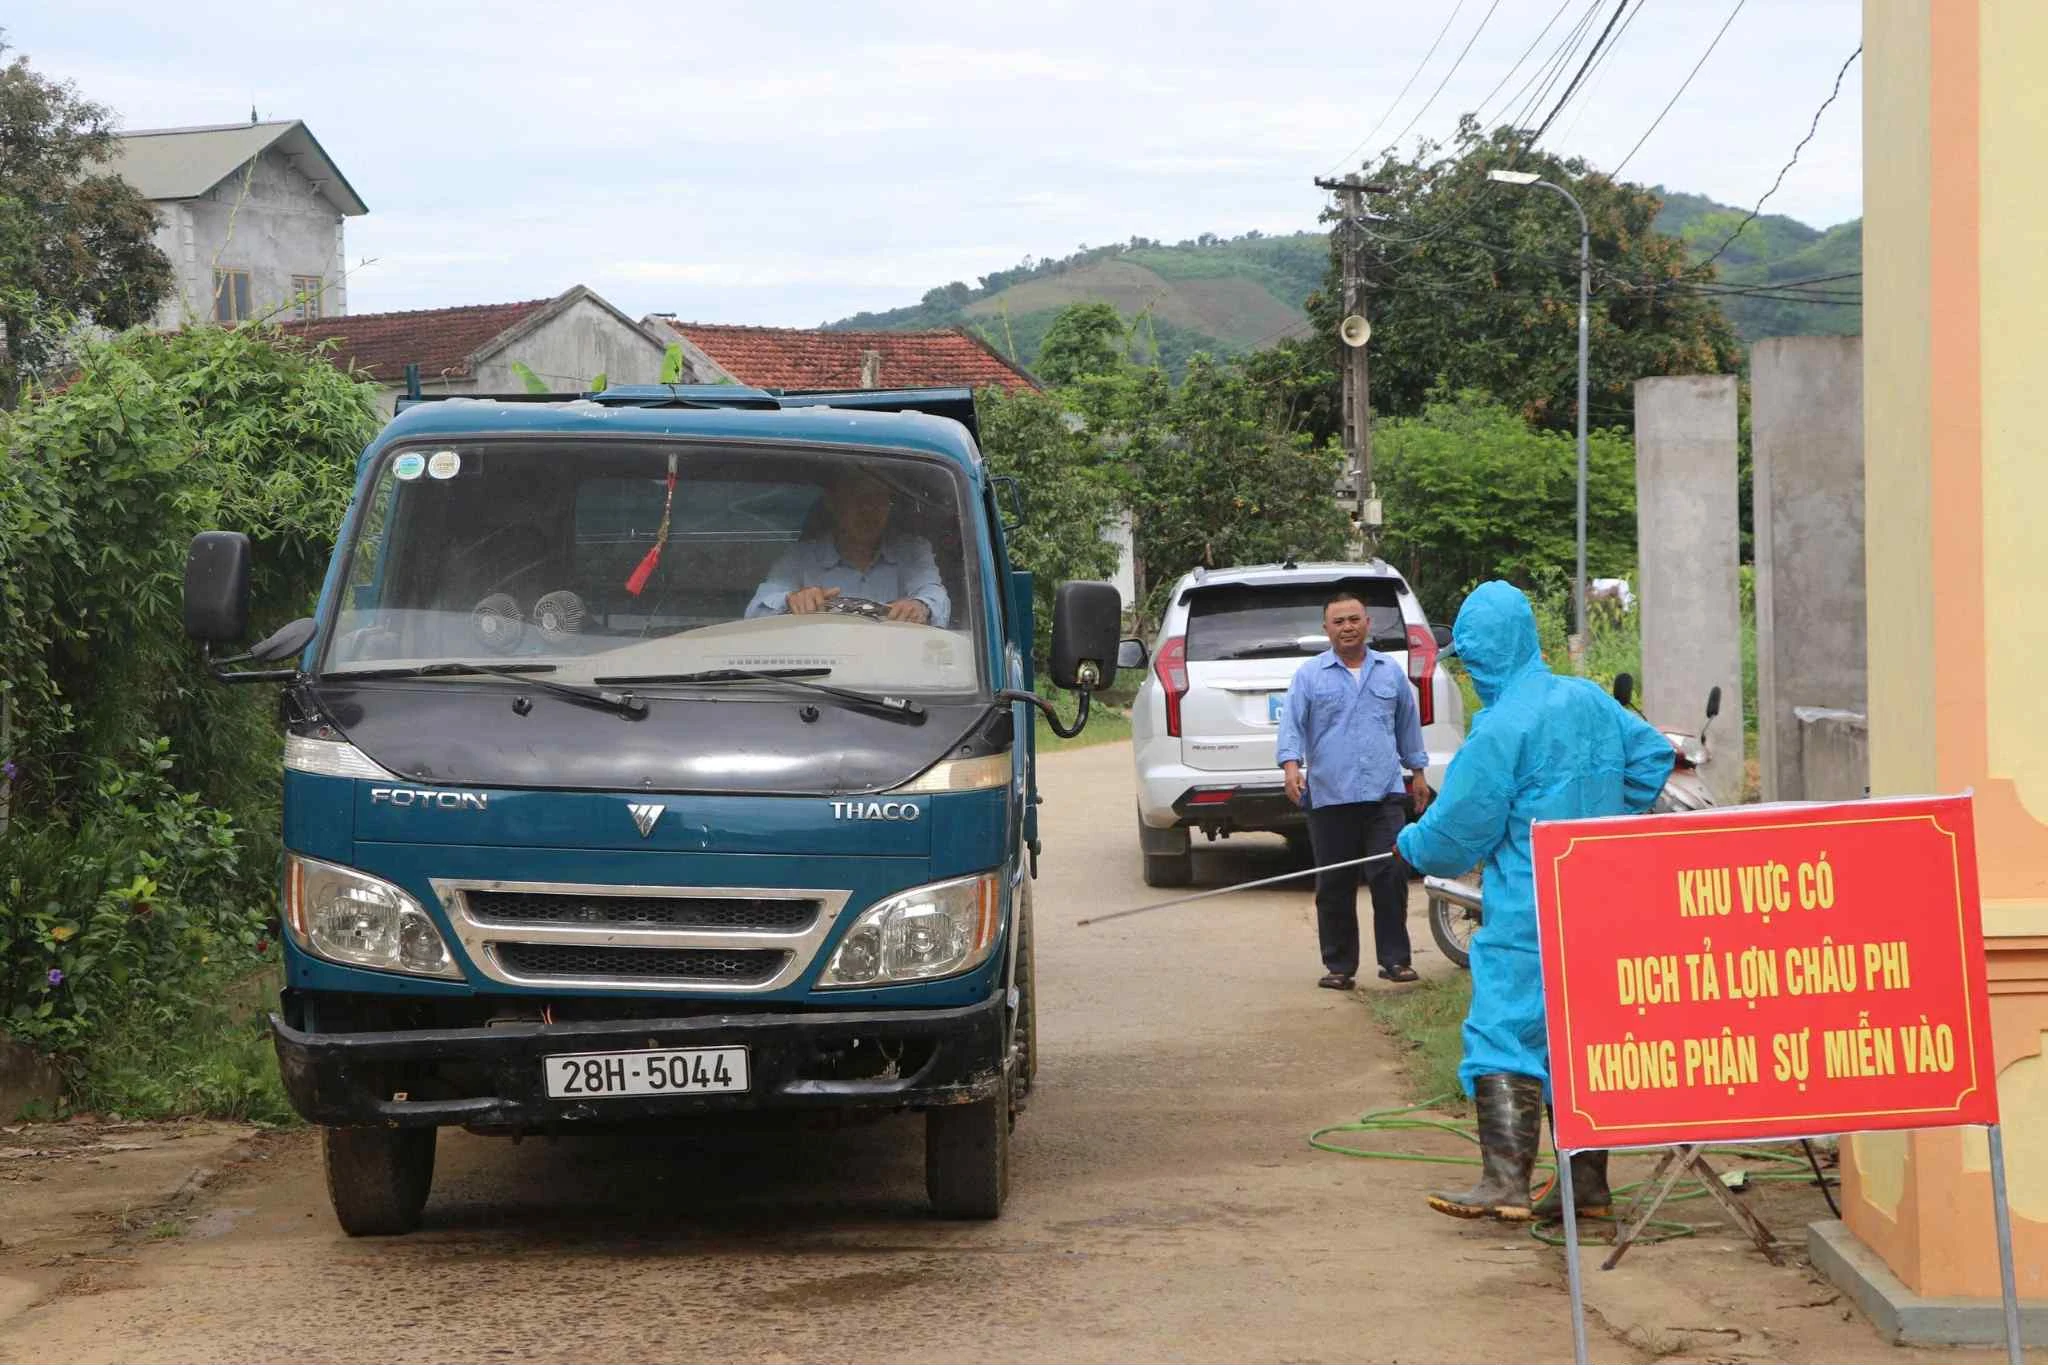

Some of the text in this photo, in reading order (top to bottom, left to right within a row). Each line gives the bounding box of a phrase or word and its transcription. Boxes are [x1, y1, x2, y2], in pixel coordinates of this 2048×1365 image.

[371, 788, 488, 810] FOTON
[829, 802, 920, 821] THACO
[1678, 850, 1835, 924] KHU VỰC CÓ
[1617, 935, 1910, 1015] DỊCH TẢ LỢN CHÂU PHI
[562, 1054, 732, 1093] 28H-5044
[1587, 1010, 1955, 1096] KHÔNG PHẬN SỰ MIỄN VÀO
